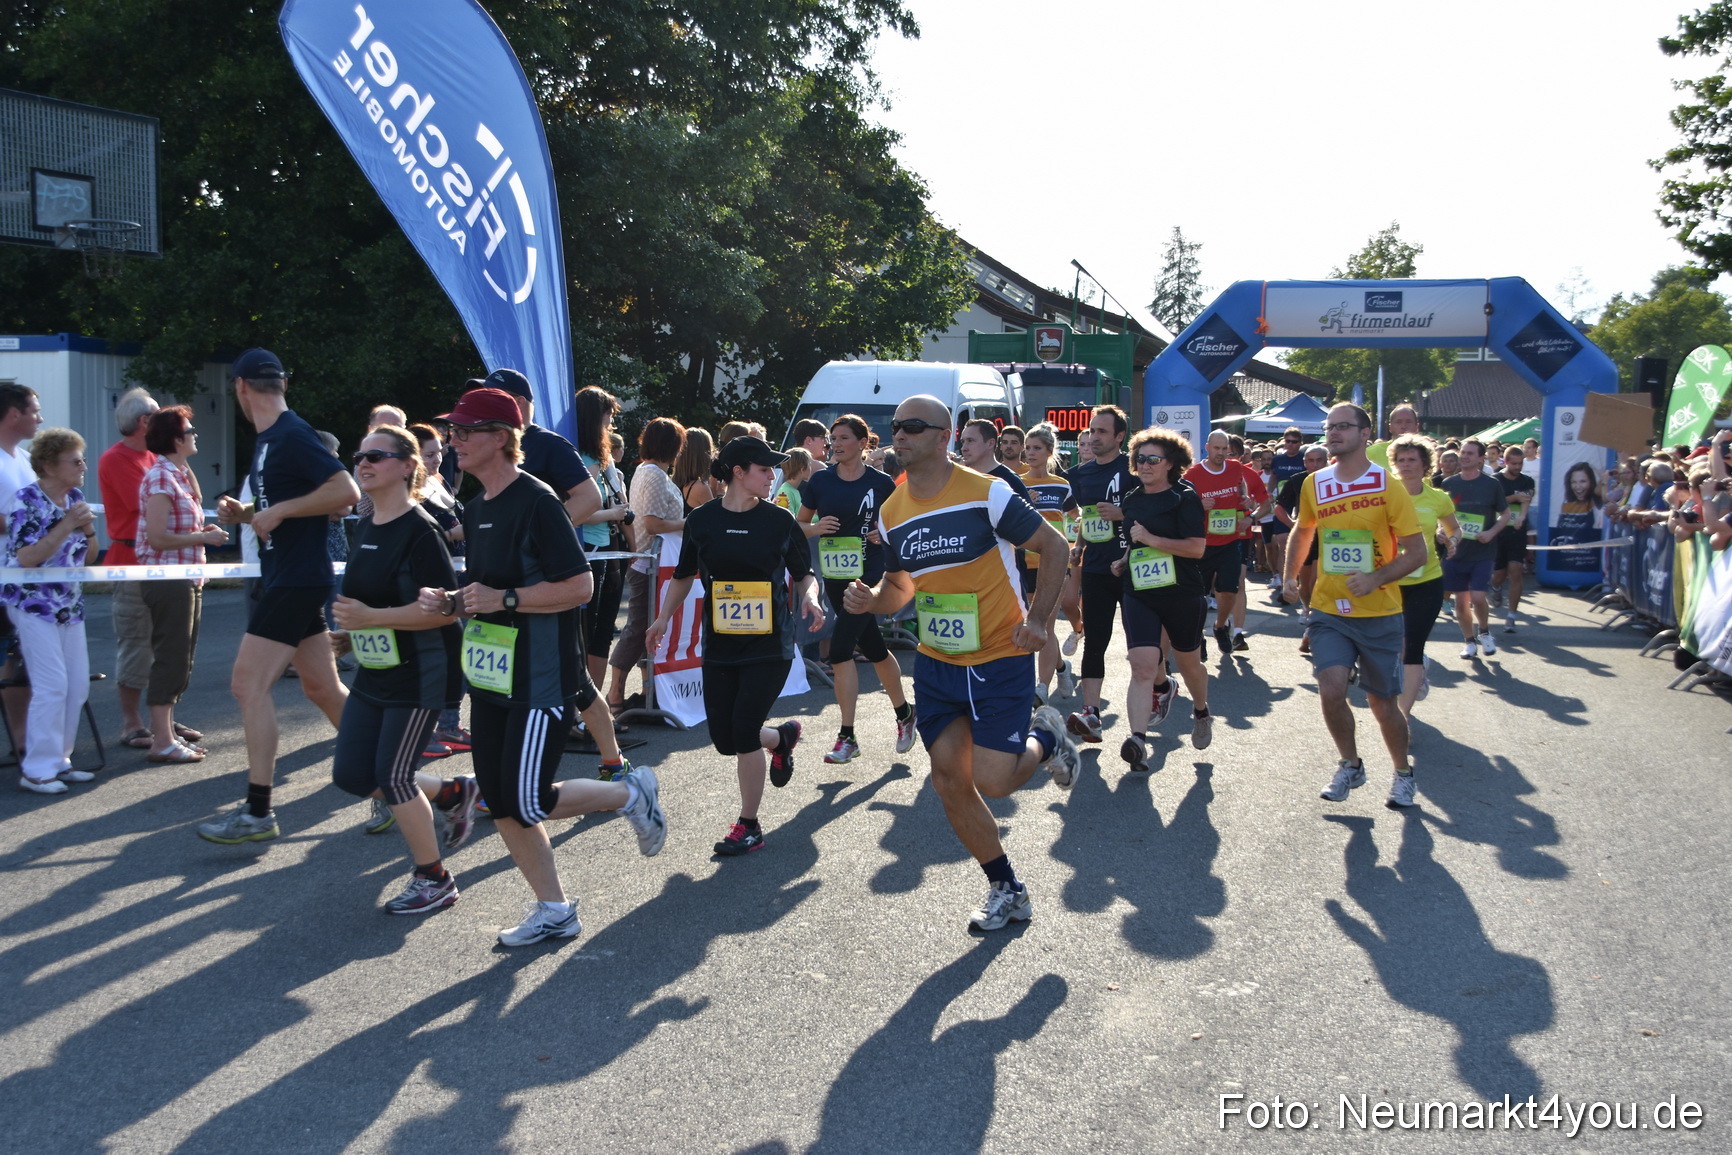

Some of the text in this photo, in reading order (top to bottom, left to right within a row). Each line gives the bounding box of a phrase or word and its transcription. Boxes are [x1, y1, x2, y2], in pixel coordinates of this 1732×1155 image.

[1351, 312, 1435, 328] firmenlauf
[1195, 341, 1239, 352] Fischer
[1696, 383, 1722, 411] AOK
[1668, 402, 1698, 435] AOK
[1201, 487, 1233, 498] NEUMARKT
[1317, 496, 1386, 519] MAX BÖGL
[1085, 520, 1110, 533] 1143
[1211, 519, 1234, 528] 1397
[910, 535, 967, 555] Fischer
[916, 547, 965, 560] AUTOMOBILE
[824, 553, 859, 568] 1132
[1331, 548, 1363, 563] 863
[1134, 561, 1169, 579] 1241
[719, 602, 764, 620] 1211
[928, 617, 965, 639] 428
[353, 632, 391, 653] 1213
[467, 646, 508, 674] 1214
